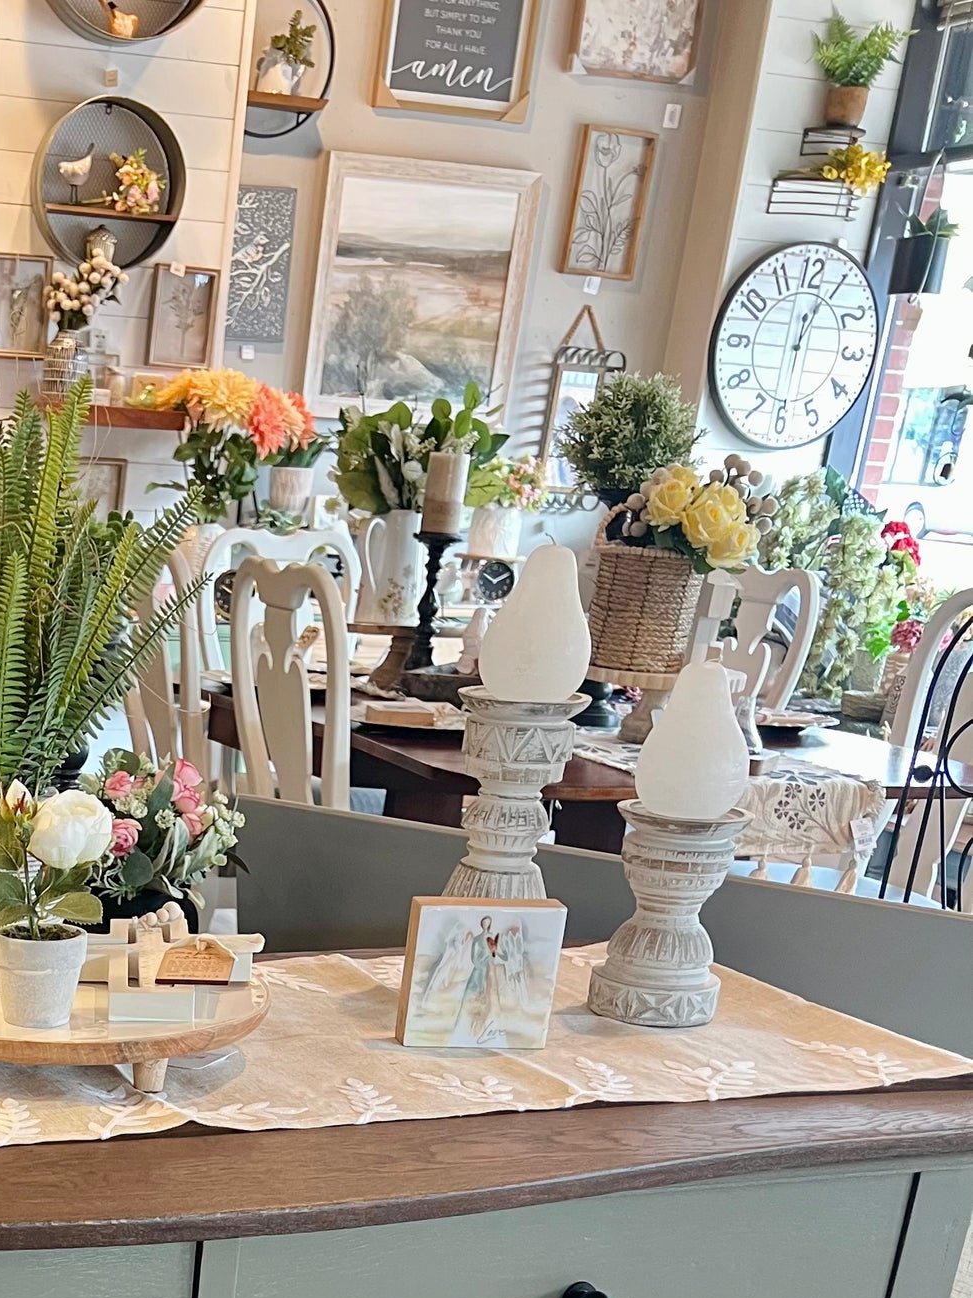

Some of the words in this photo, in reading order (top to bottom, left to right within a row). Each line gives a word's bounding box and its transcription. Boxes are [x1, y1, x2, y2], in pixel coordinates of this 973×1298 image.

[424, 8, 439, 18] BUT
[440, 10, 467, 21] SIMPLY
[469, 13, 481, 24] TO
[481, 15, 496, 24] SAY
[435, 25, 463, 37] THANK
[465, 29, 483, 39] YOU
[425, 39, 442, 50] FOR
[442, 42, 459, 52] ALL
[391, 59, 514, 92] amen
[772, 262, 791, 296] 11
[800, 256, 826, 290] 12
[828, 273, 849, 301] 1
[740, 288, 768, 322] 10
[840, 305, 866, 329] 2
[726, 333, 752, 349] 9
[841, 345, 865, 362] 3
[726, 368, 751, 390] 8
[830, 376, 849, 400] 4
[744, 391, 768, 420] 7
[804, 398, 819, 428] 5
[774, 405, 787, 436] 6
